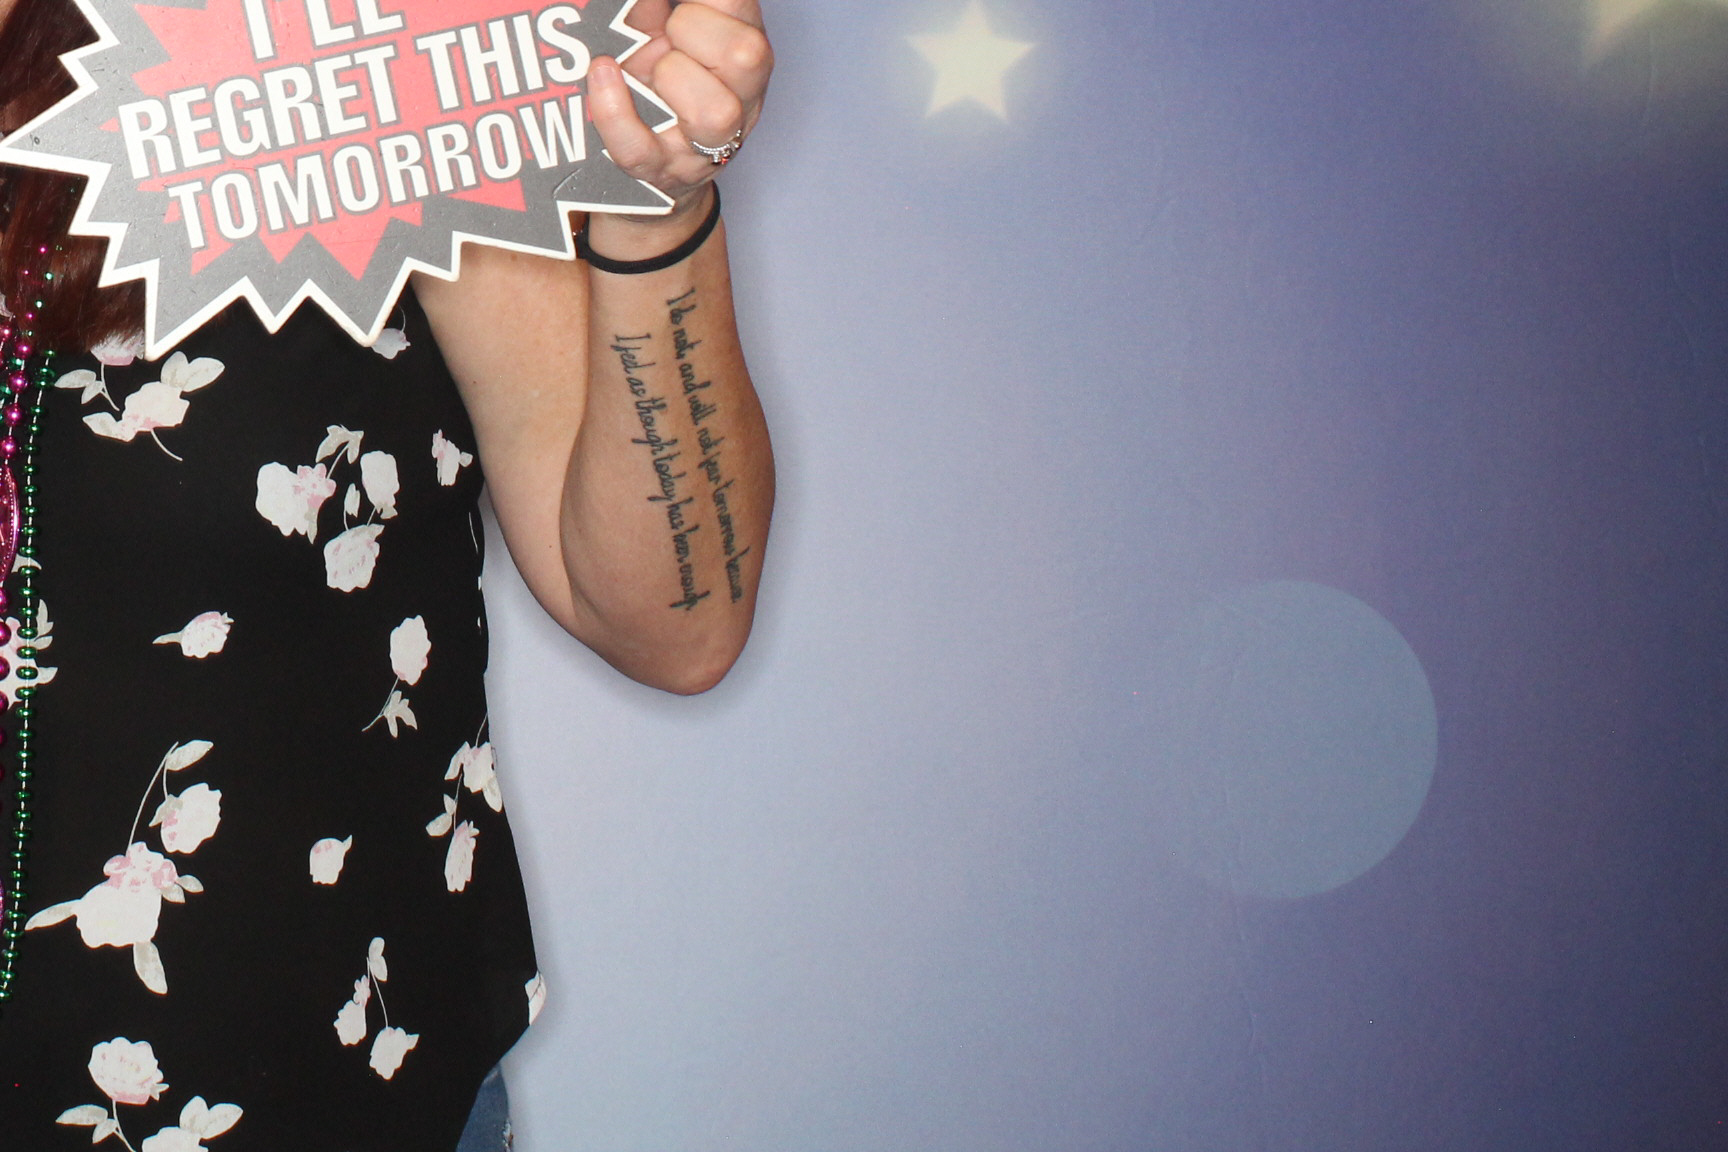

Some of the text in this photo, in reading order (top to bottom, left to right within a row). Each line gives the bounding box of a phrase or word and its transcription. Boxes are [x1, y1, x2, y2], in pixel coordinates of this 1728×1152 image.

[118, 5, 591, 180] REGRET THIS
[169, 95, 586, 250] TOMORROW
[614, 332, 652, 342] I
[610, 343, 657, 375] feel
[626, 376, 647, 398] as
[679, 363, 712, 395] and
[631, 397, 678, 455] though
[688, 395, 717, 426] will
[697, 427, 725, 455] not
[646, 451, 687, 502] today
[666, 497, 694, 530] has
